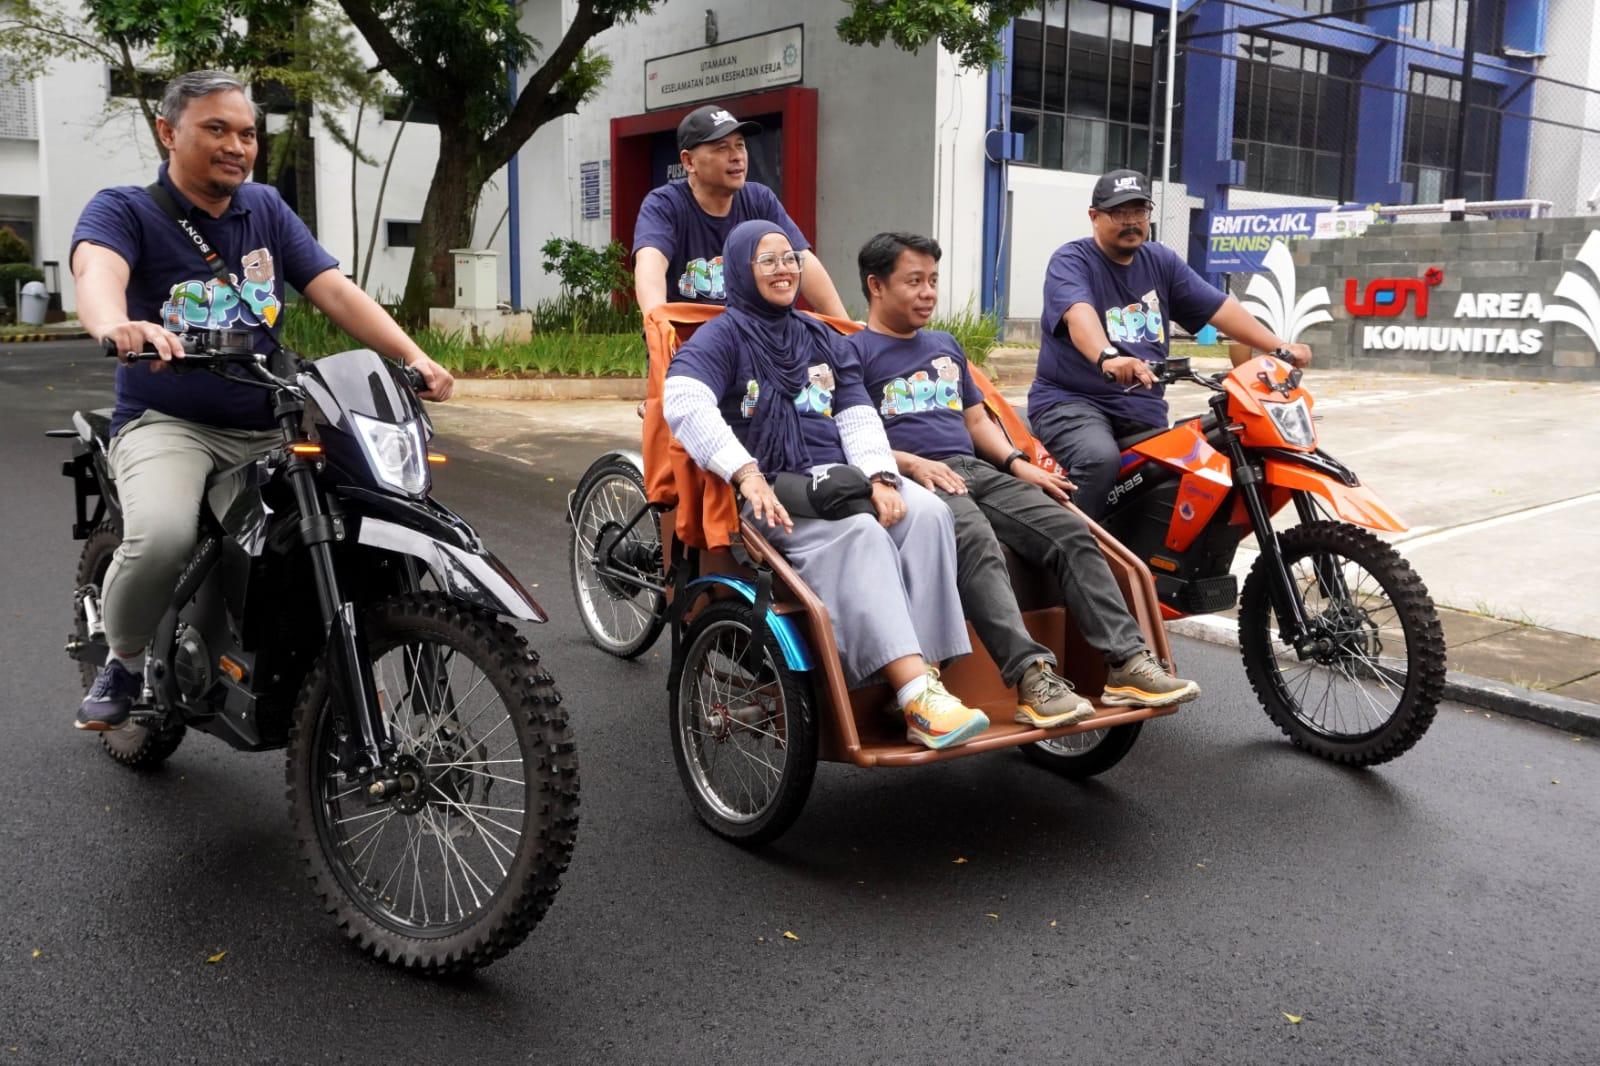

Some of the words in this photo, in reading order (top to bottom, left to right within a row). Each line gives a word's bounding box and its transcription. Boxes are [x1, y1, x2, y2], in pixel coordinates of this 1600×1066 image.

[661, 76, 704, 94] KESELAMATAN
[705, 74, 720, 87] DAN
[721, 66, 759, 82] KESEHATAN
[760, 61, 781, 75] KERJA
[700, 56, 737, 72] UTAMAKAN
[666, 163, 687, 179] PUSA
[178, 219, 211, 253] SONY
[1210, 236, 1271, 253] TENNIS
[1454, 292, 1546, 319] AREA
[1363, 325, 1544, 355] KOMUNITAS
